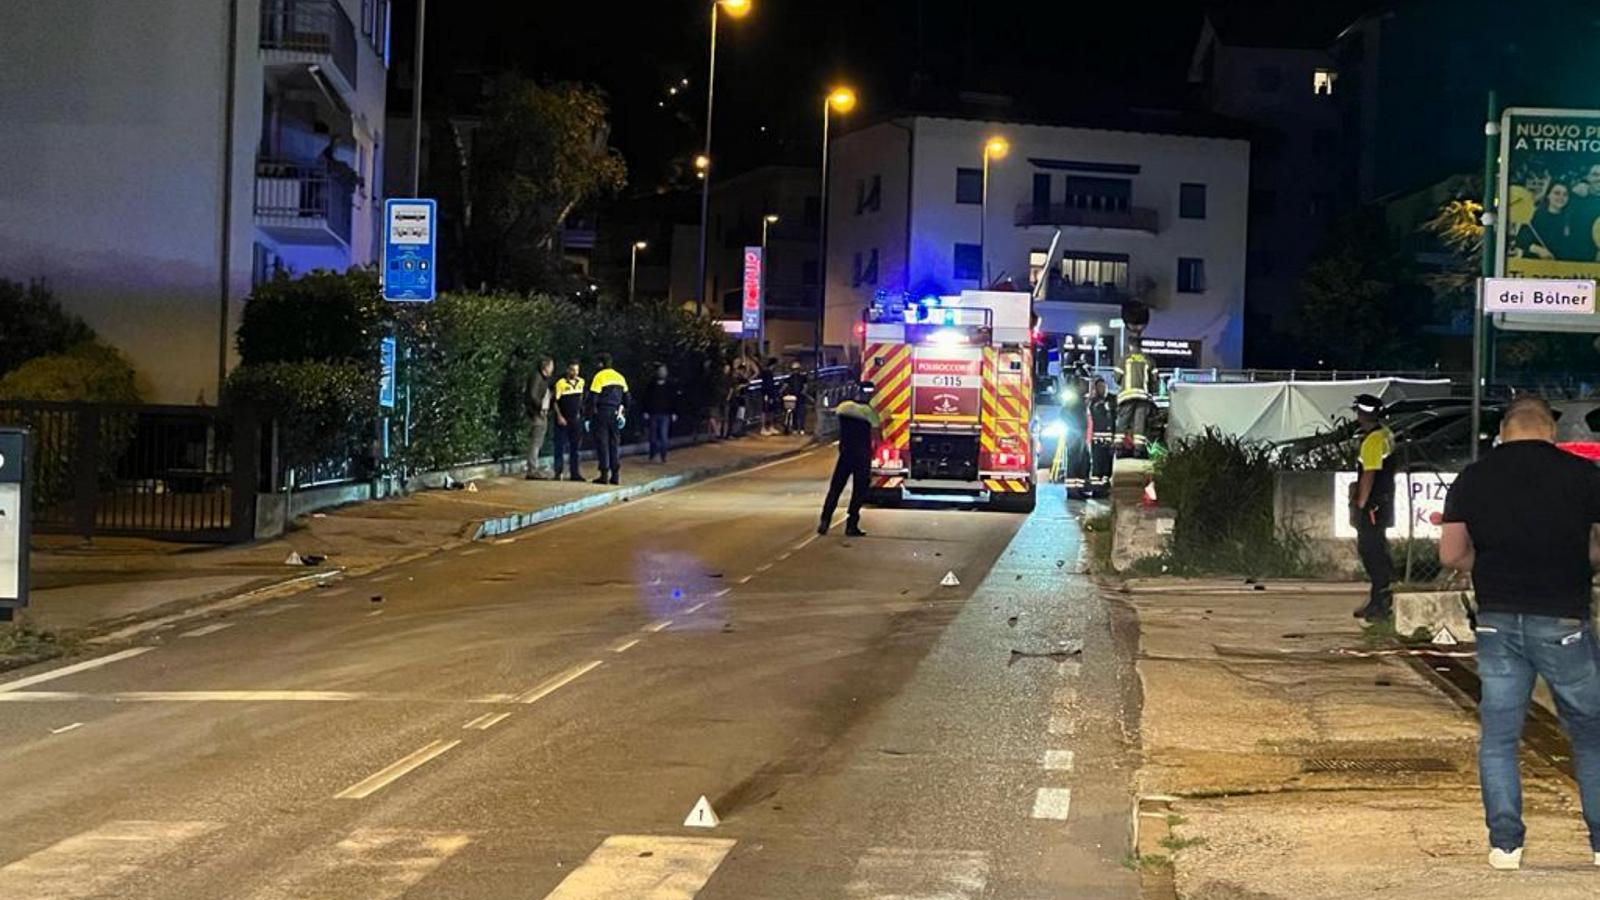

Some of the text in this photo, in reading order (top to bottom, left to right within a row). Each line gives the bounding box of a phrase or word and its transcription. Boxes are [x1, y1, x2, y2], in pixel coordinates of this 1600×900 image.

[1516, 124, 1580, 138] NUOVO
[1515, 138, 1600, 152] A TRENTO
[1499, 290, 1524, 304] dei
[944, 375, 962, 387] 115
